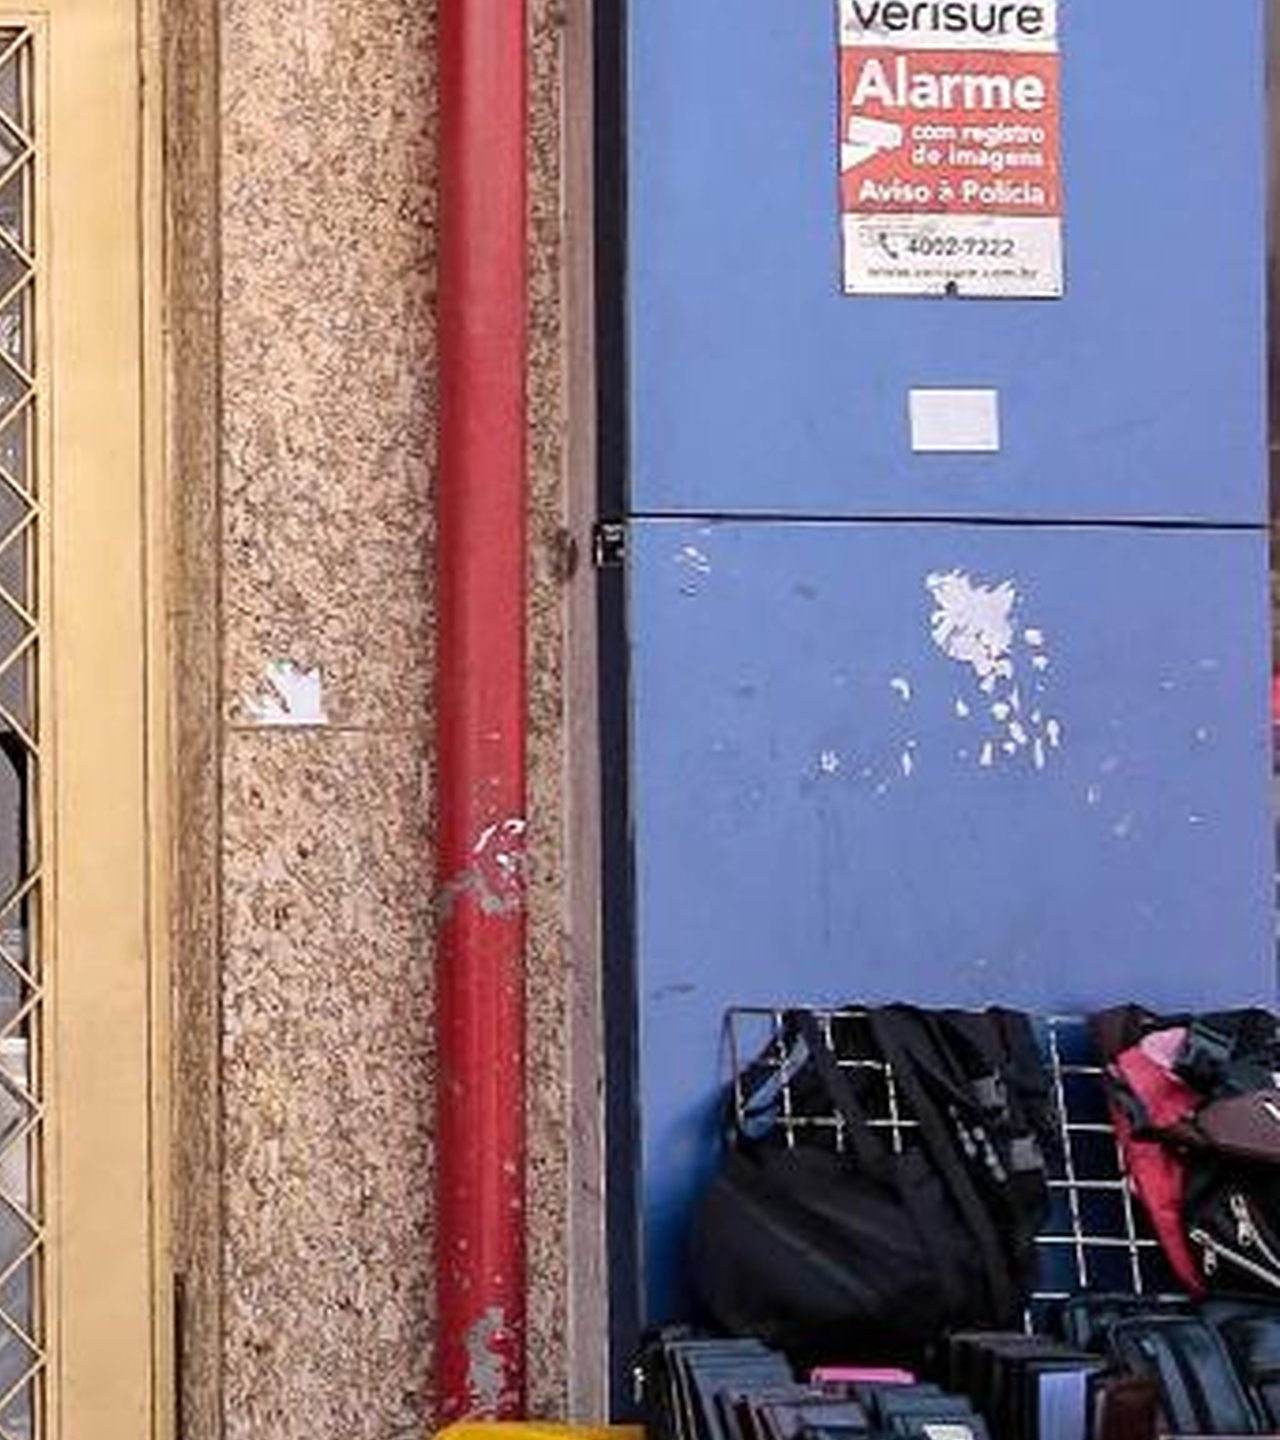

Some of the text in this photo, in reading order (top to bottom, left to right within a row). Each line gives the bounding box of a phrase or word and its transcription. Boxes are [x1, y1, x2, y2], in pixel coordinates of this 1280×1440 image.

[851, 0, 1044, 35] verisure
[851, 56, 1046, 111] Alarme
[911, 124, 957, 140] com
[911, 145, 1044, 171] de imagens
[858, 179, 931, 203] Aviso
